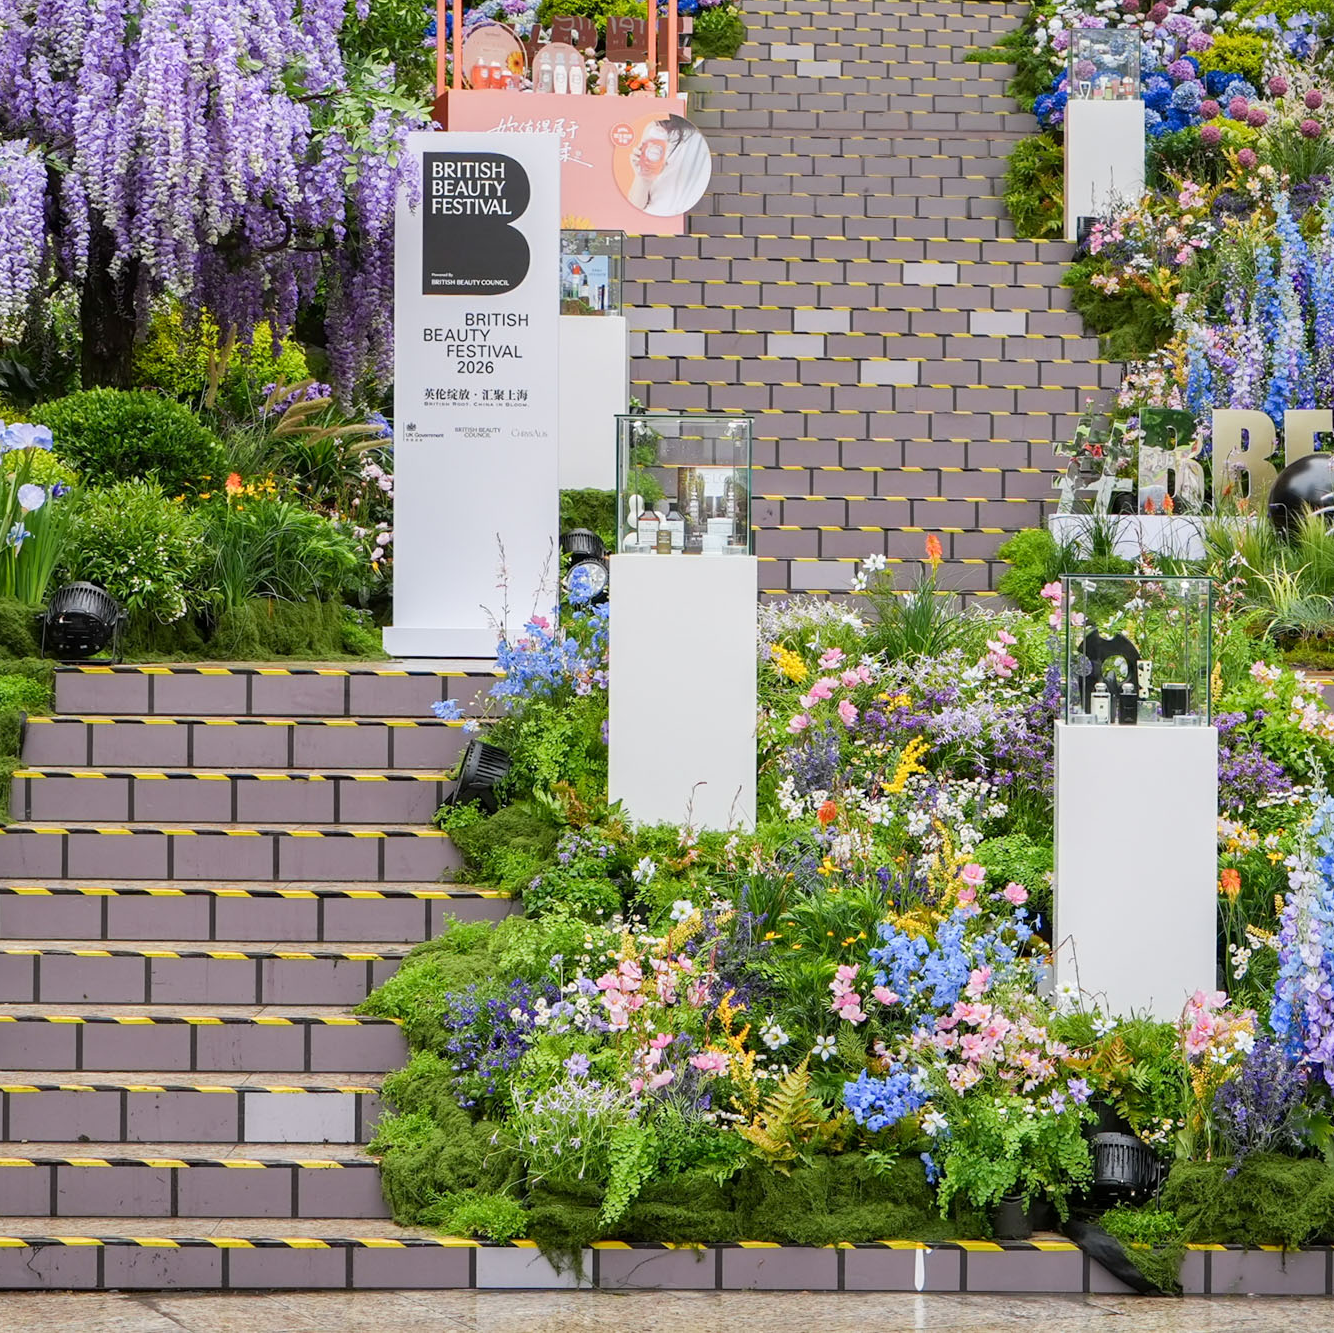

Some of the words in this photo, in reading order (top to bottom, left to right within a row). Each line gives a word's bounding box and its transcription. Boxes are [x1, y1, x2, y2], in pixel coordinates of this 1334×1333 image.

[431, 161, 506, 179] BRITISH
[431, 179, 506, 197] BEAUTY
[431, 198, 513, 215] FESTIVAL
[431, 278, 456, 286] BRITISH
[481, 279, 510, 287] COUNCIL
[465, 313, 529, 327] BRITISH
[423, 328, 491, 342] BEAUTY
[446, 344, 523, 358] FESTIVAL
[457, 360, 495, 374] 2026
